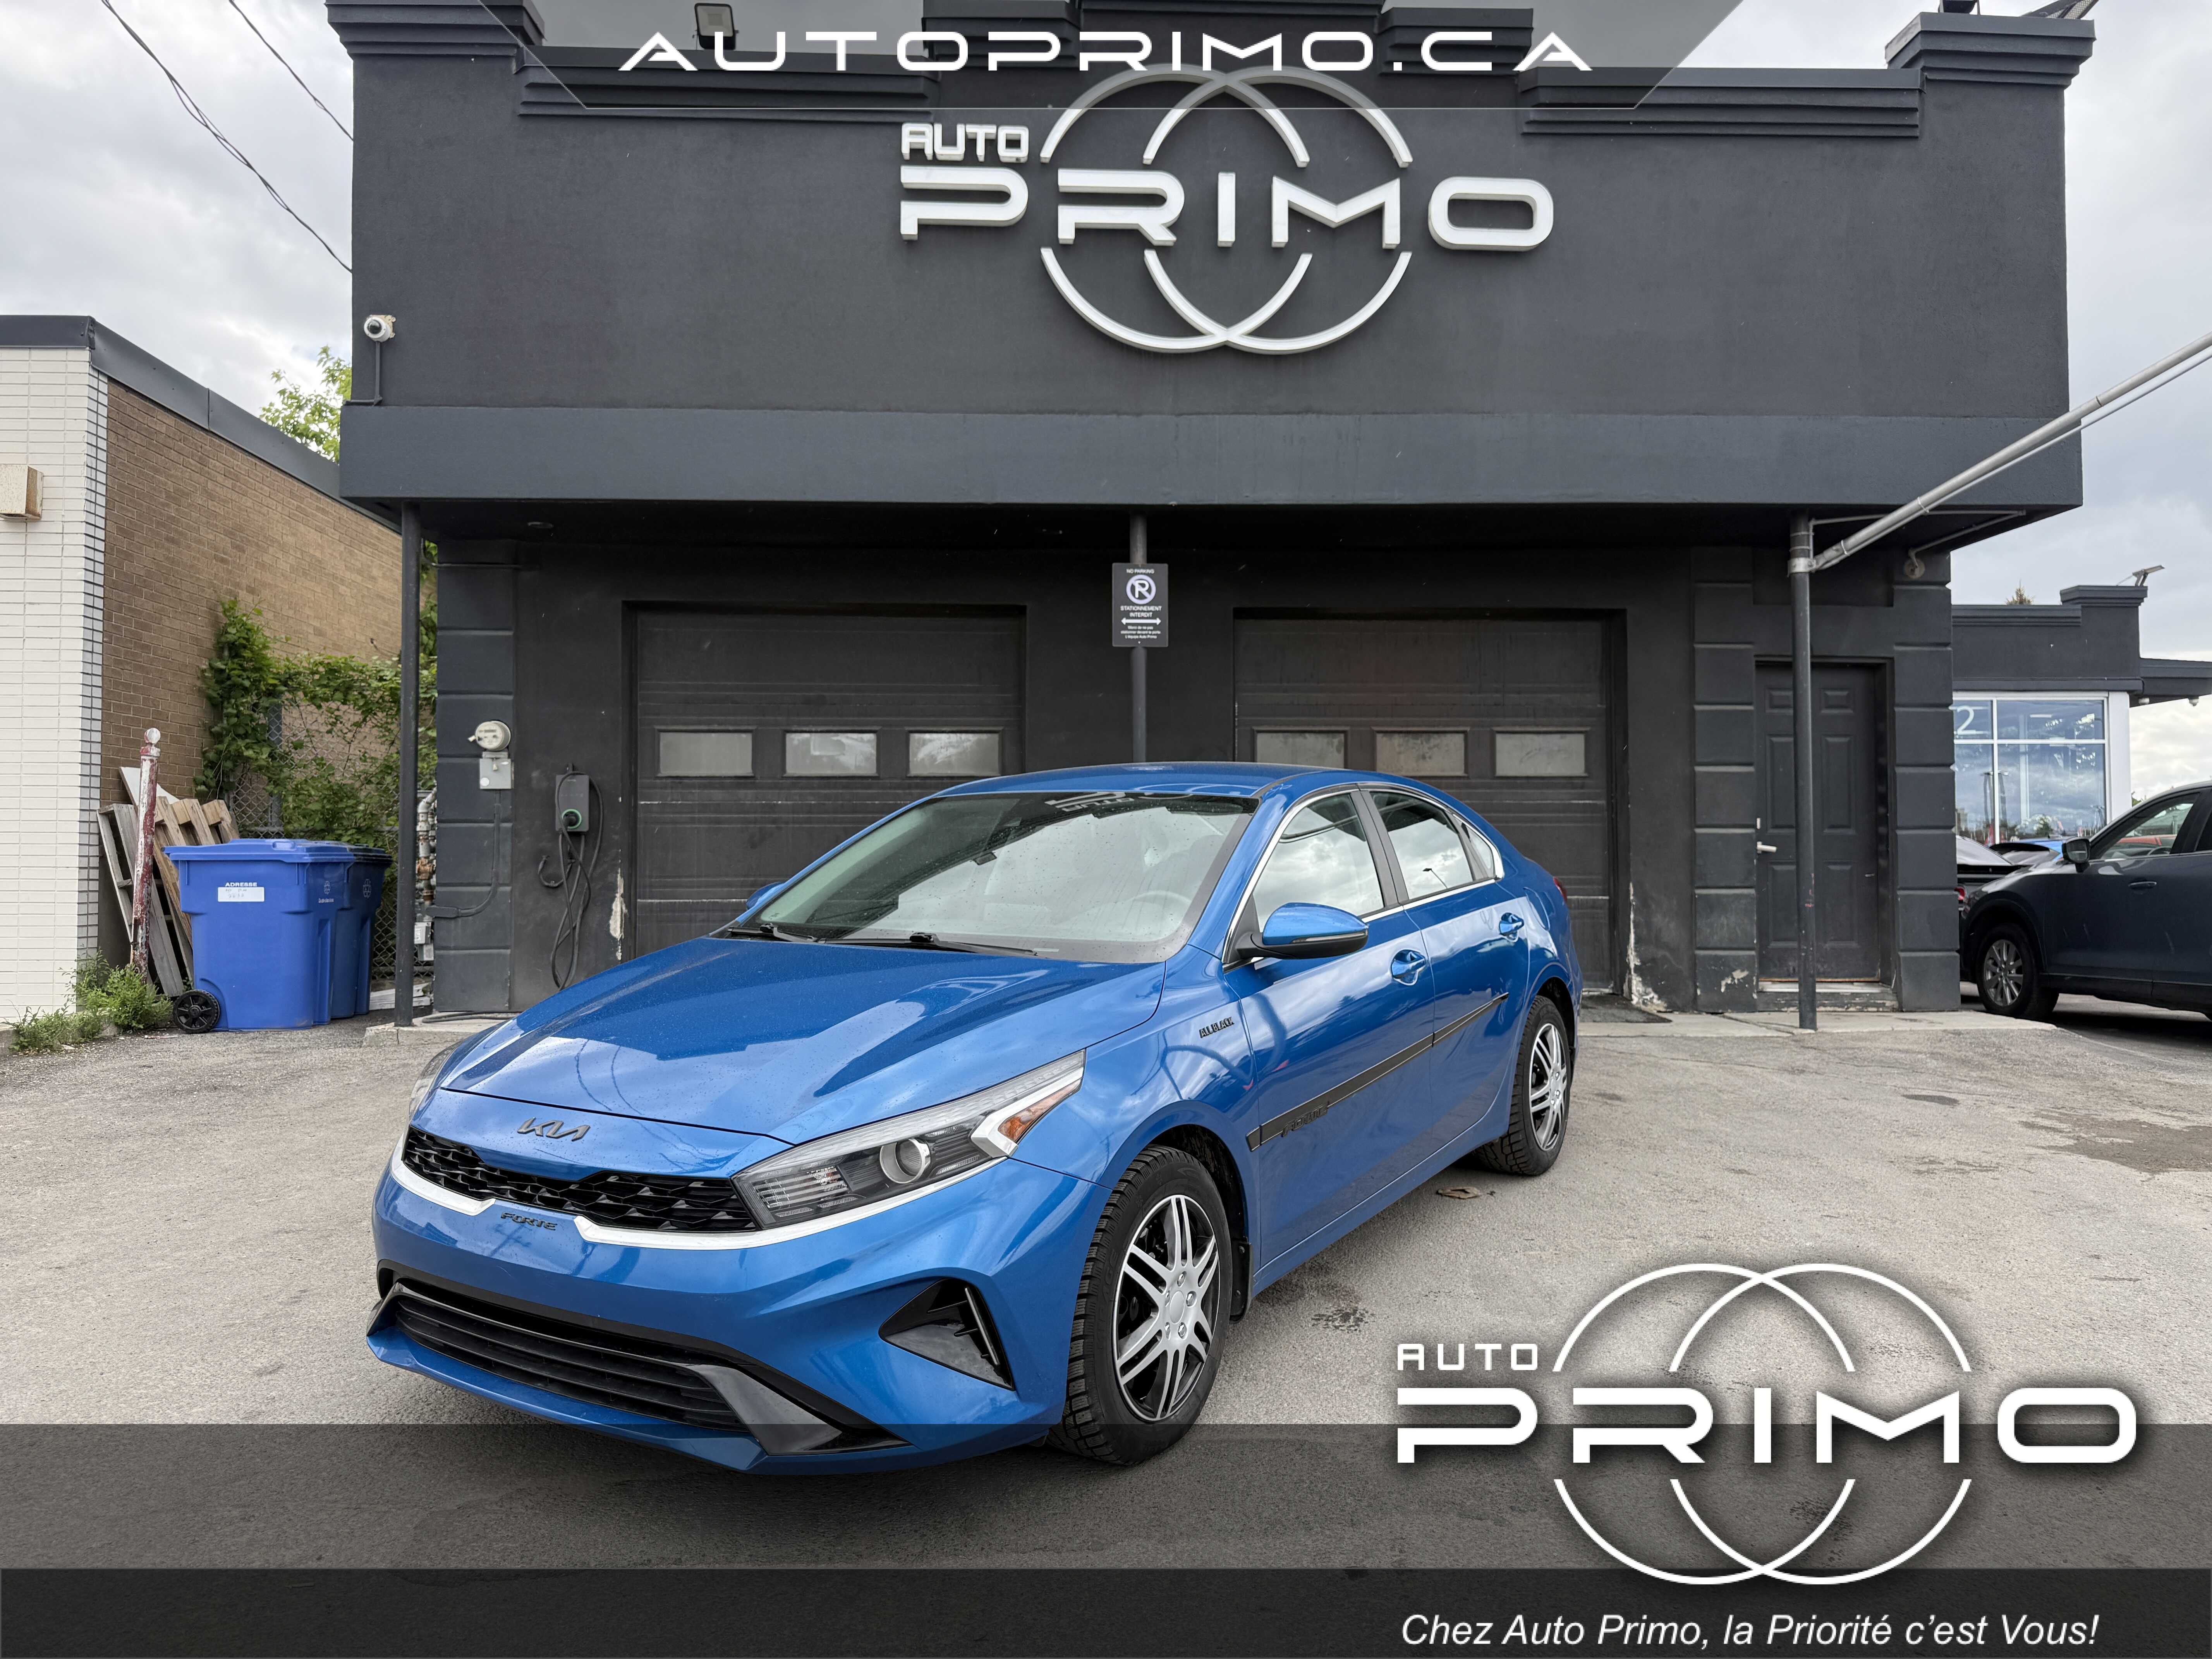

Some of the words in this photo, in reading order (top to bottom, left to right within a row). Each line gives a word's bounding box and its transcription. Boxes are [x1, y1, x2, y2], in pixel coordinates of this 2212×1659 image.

[901, 123, 1029, 163] AUTO
[900, 165, 1554, 251] PRIMO
[1199, 1026, 1214, 1038] ALL
[1211, 1017, 1234, 1032] BLACK
[517, 1117, 591, 1142] KIA
[501, 1212, 558, 1231] FORTE
